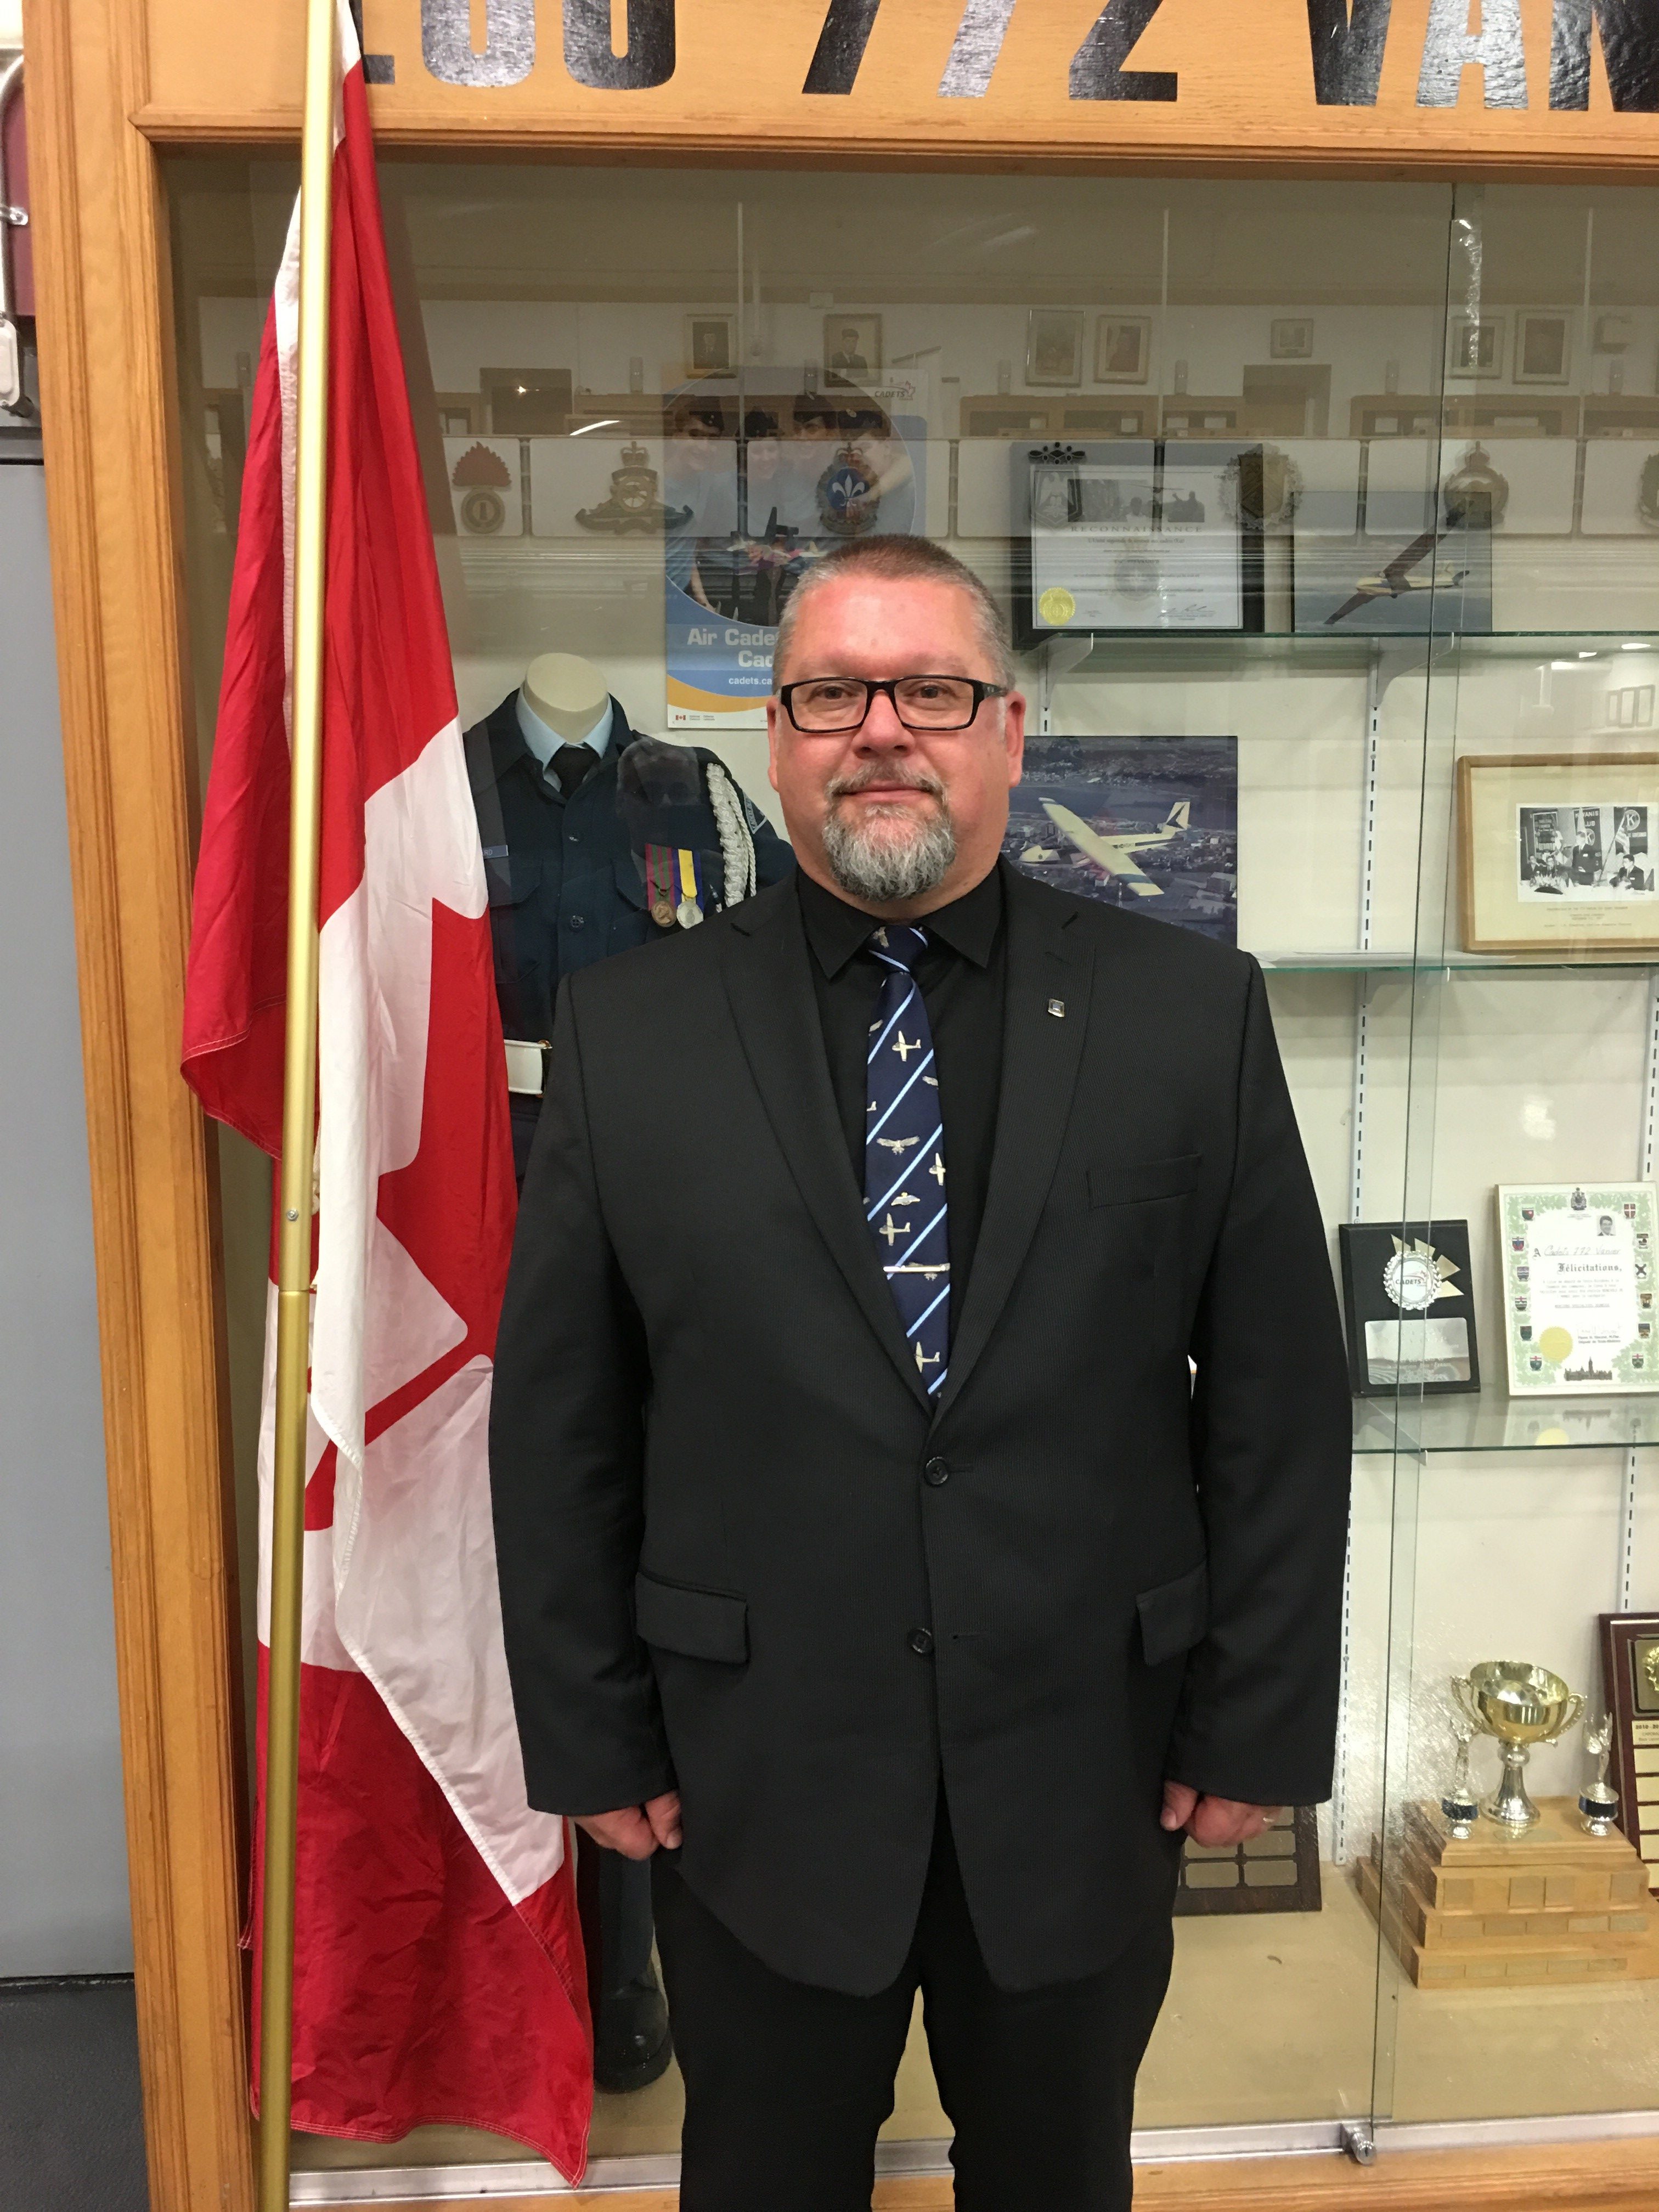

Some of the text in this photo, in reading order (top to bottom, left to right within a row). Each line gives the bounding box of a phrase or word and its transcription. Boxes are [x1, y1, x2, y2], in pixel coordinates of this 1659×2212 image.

[687, 628, 718, 645] Air
[729, 676, 772, 685] cadets.ca
[1558, 1263, 1622, 1273] Félicitations,
